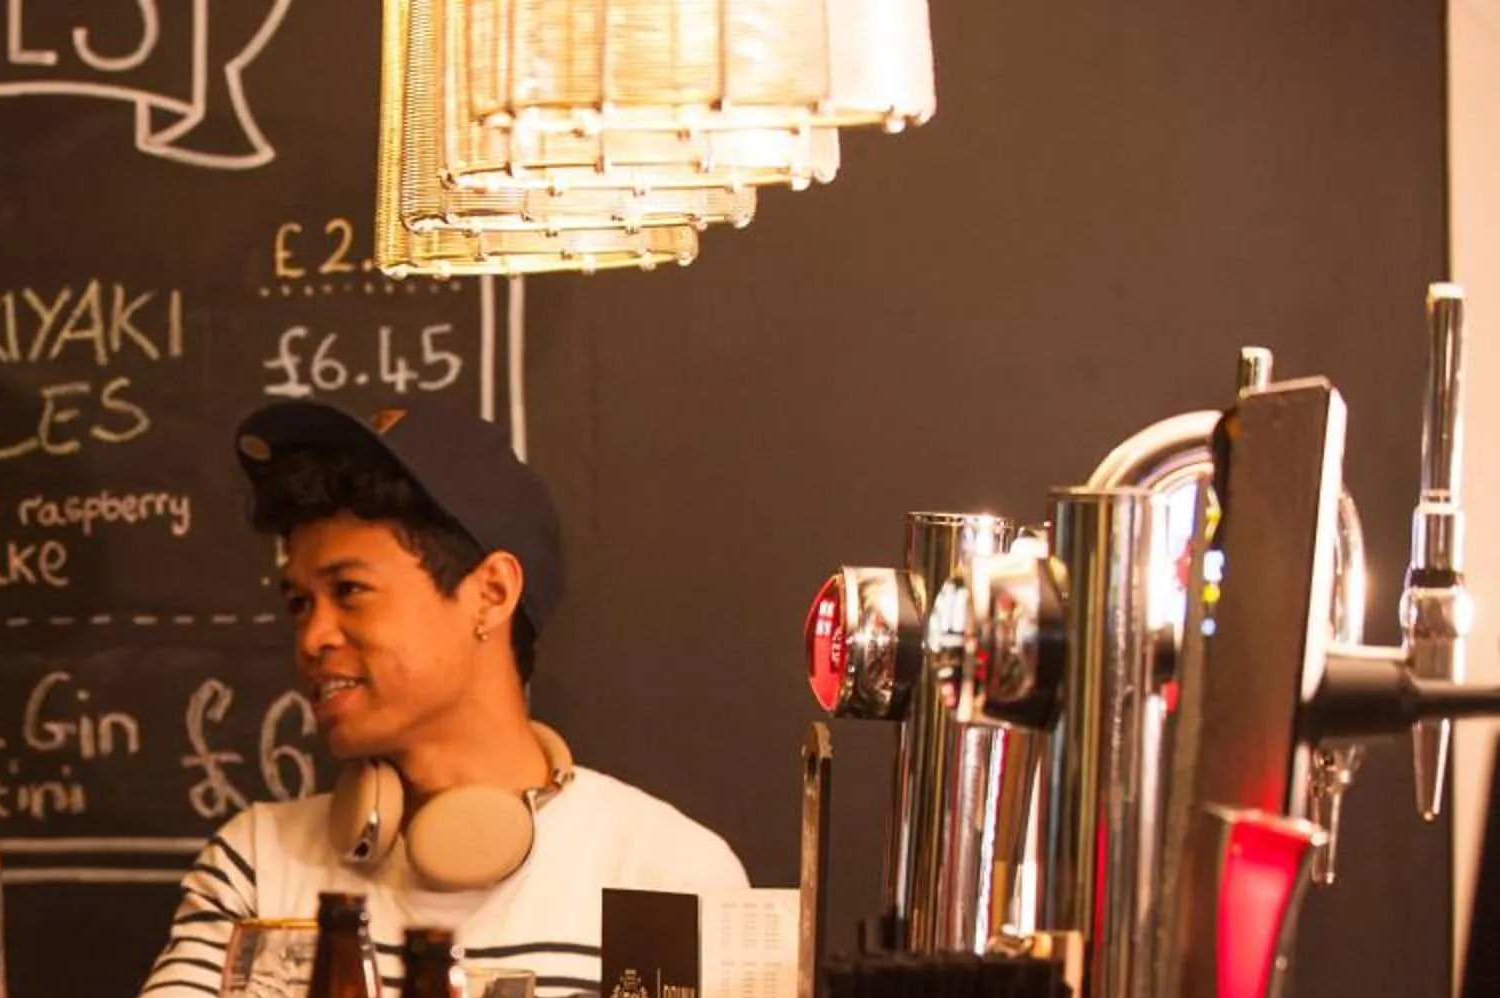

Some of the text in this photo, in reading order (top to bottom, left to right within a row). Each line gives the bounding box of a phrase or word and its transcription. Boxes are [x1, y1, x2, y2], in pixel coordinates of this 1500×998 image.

[263, 322, 464, 398] £6.45
[18, 490, 190, 536] raspberry
[22, 671, 141, 759] Gin
